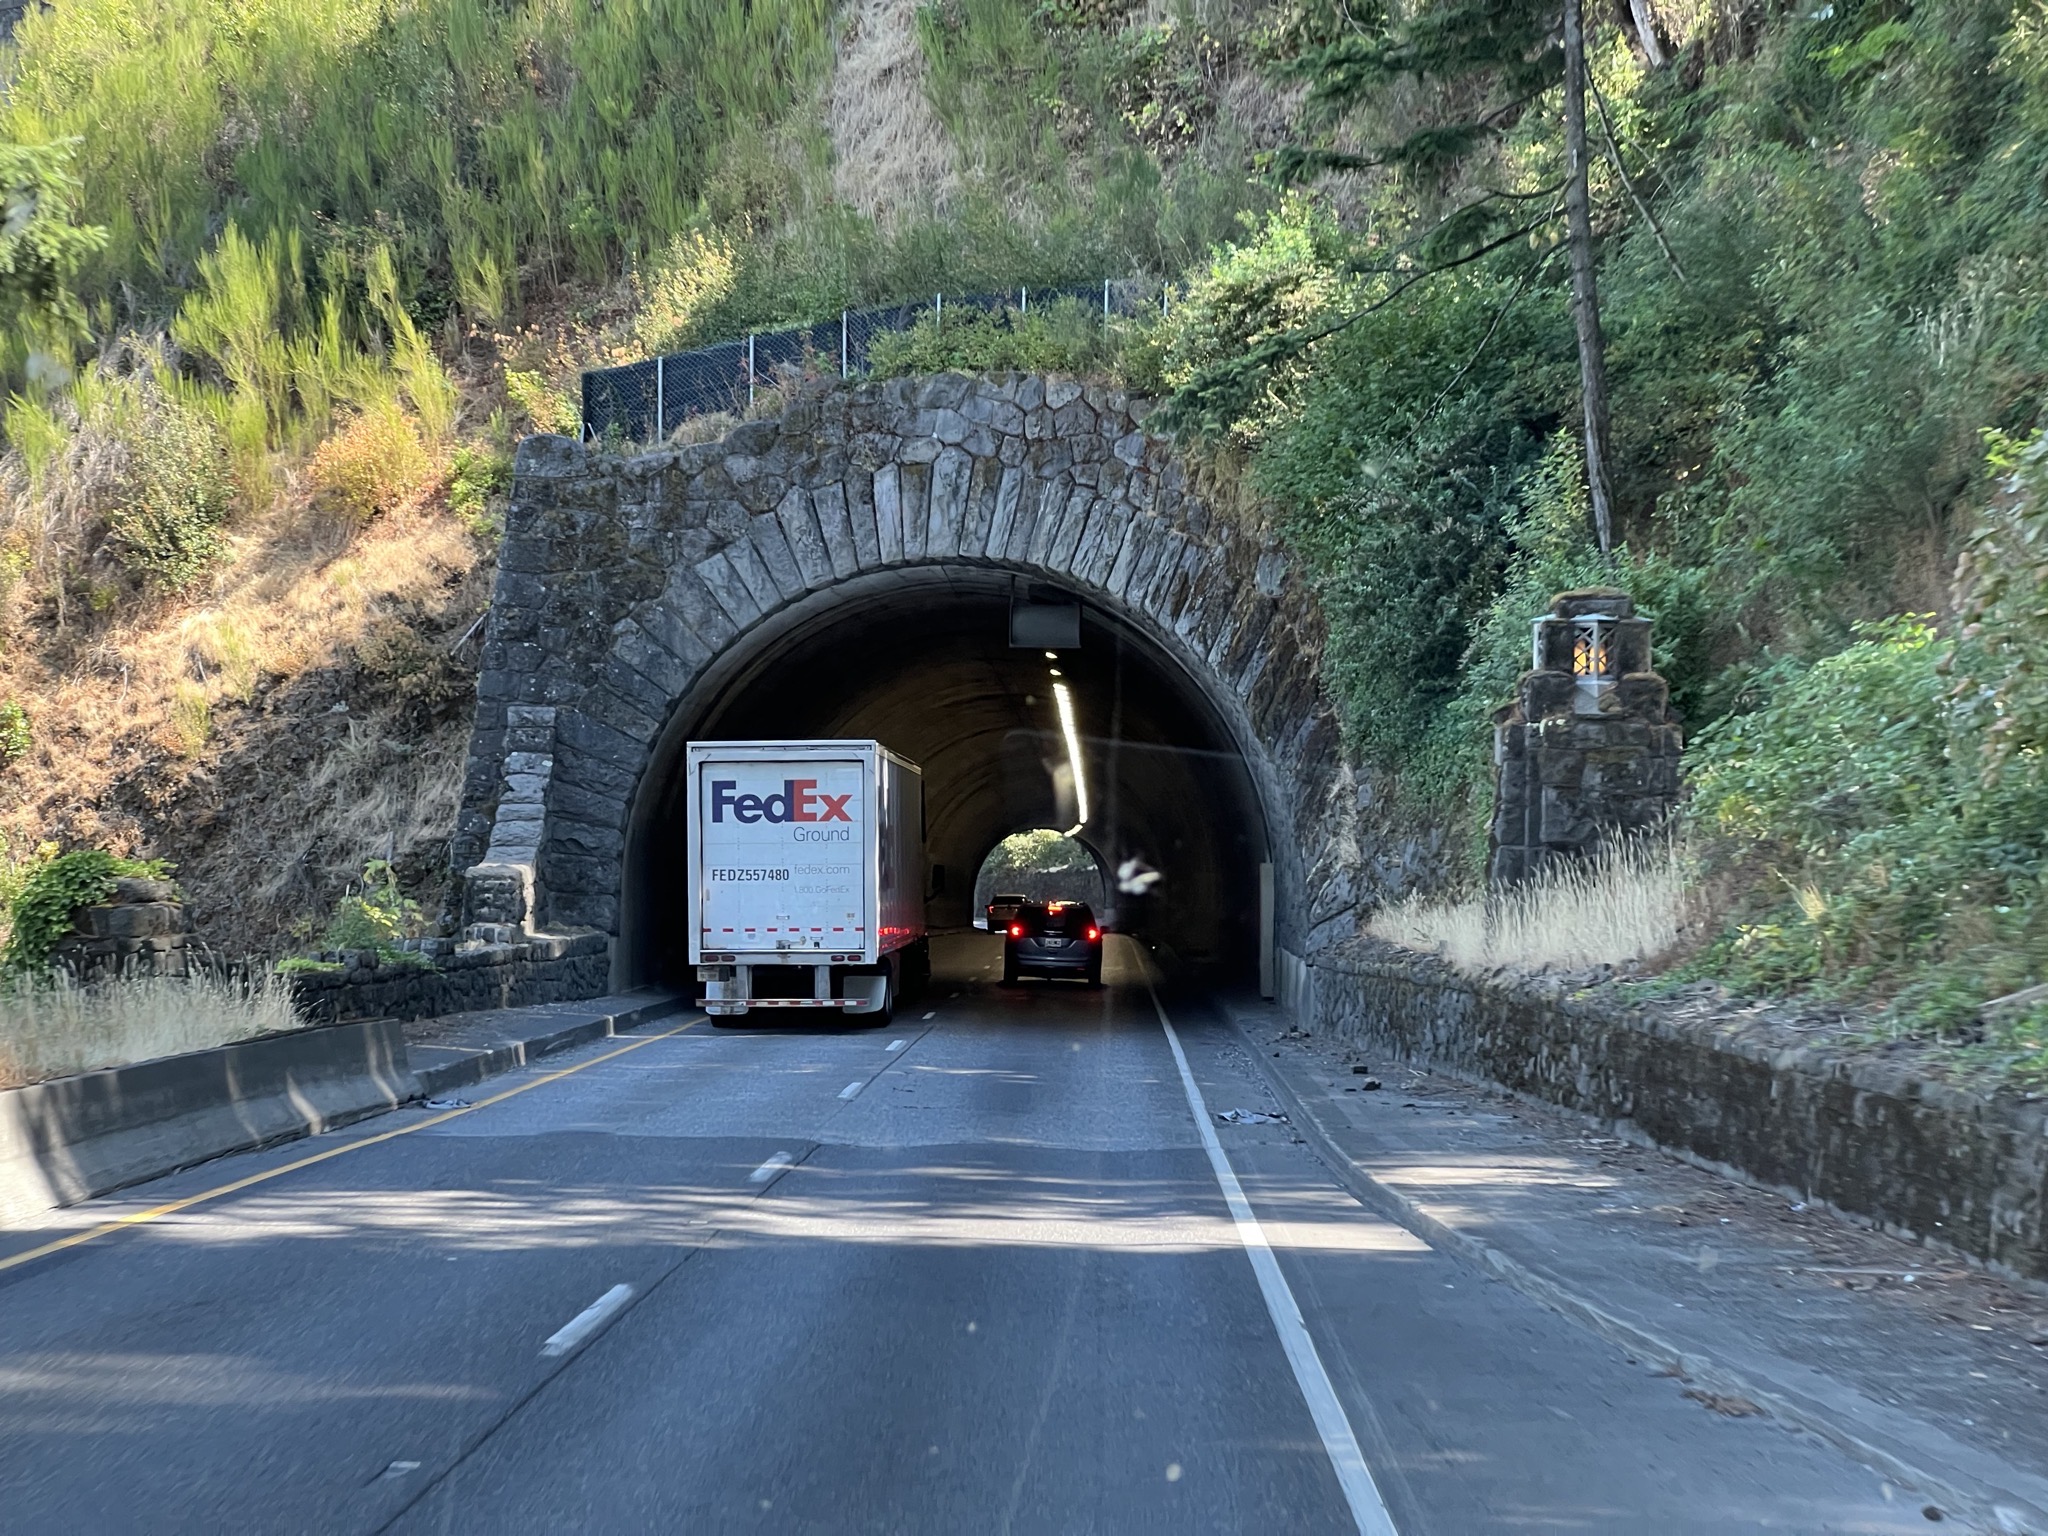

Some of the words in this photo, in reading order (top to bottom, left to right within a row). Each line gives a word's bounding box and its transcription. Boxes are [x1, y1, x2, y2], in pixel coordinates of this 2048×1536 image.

[712, 779, 853, 824] FedEx
[793, 826, 850, 842] Ground
[712, 869, 790, 882] FEDZ557480
[794, 864, 850, 875] fedex.com
